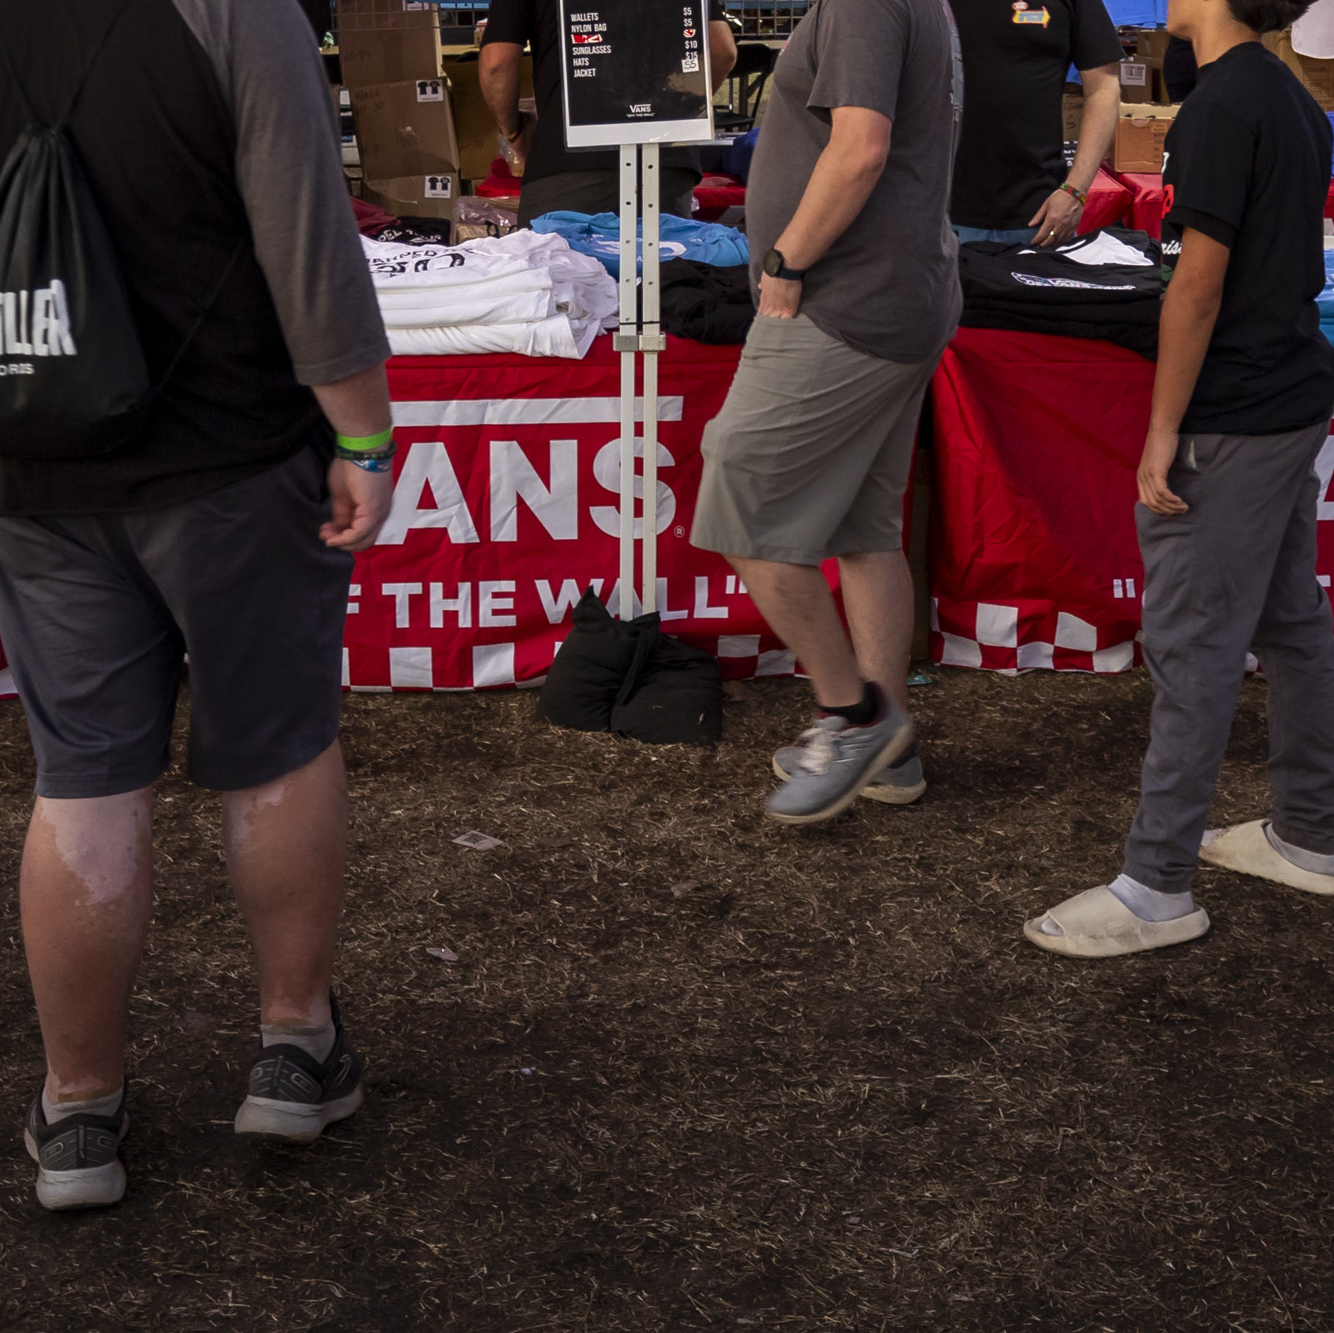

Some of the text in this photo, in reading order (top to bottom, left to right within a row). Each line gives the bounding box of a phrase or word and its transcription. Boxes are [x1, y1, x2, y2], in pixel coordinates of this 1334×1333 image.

[571, 7, 692, 22] WALLETS $5
[571, 18, 692, 33] NYLON BAG $5
[572, 40, 698, 55] SUNGLASSES $10
[573, 58, 589, 66] HATS
[574, 68, 596, 78] JACKET
[629, 103, 651, 113] VANS
[376, 396, 684, 545] ANS
[382, 581, 516, 628] THE
